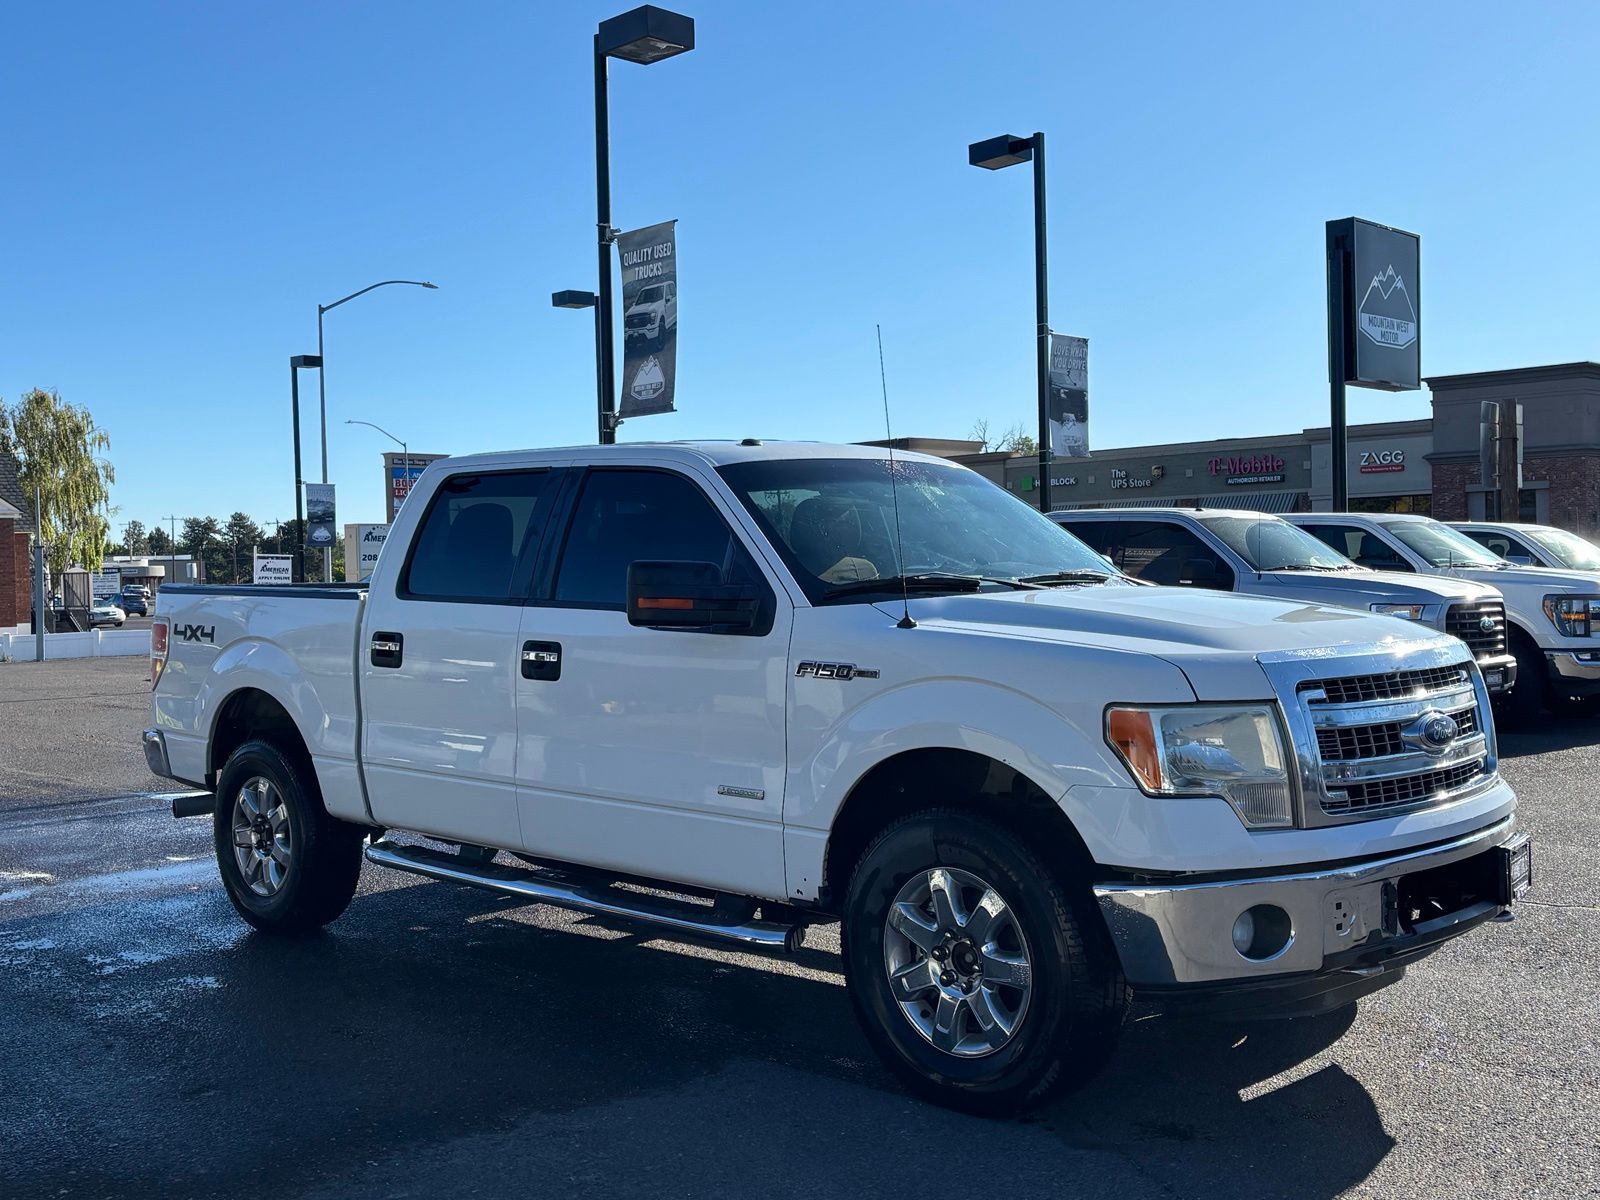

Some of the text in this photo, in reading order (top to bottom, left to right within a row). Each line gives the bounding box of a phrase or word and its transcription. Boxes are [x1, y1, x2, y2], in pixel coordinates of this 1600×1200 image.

[624, 242, 672, 265] QUALITY USED
[635, 262, 663, 280] TRUCKS
[1368, 316, 1409, 333] MOUNTAIN WEST
[1380, 330, 1399, 343] MOTOR
[1054, 344, 1070, 356] LOVE
[1054, 357, 1067, 368] YOU
[1360, 450, 1404, 465] ZAGG
[1207, 454, 1285, 476] T-Mobile
[1111, 468, 1126, 478] The
[1227, 475, 1281, 484] AUTHORIZED RETAILER
[1050, 477, 1076, 486] BLOCK
[1111, 478, 1151, 489] UPS Store
[1433, 721, 1453, 740] Ford
